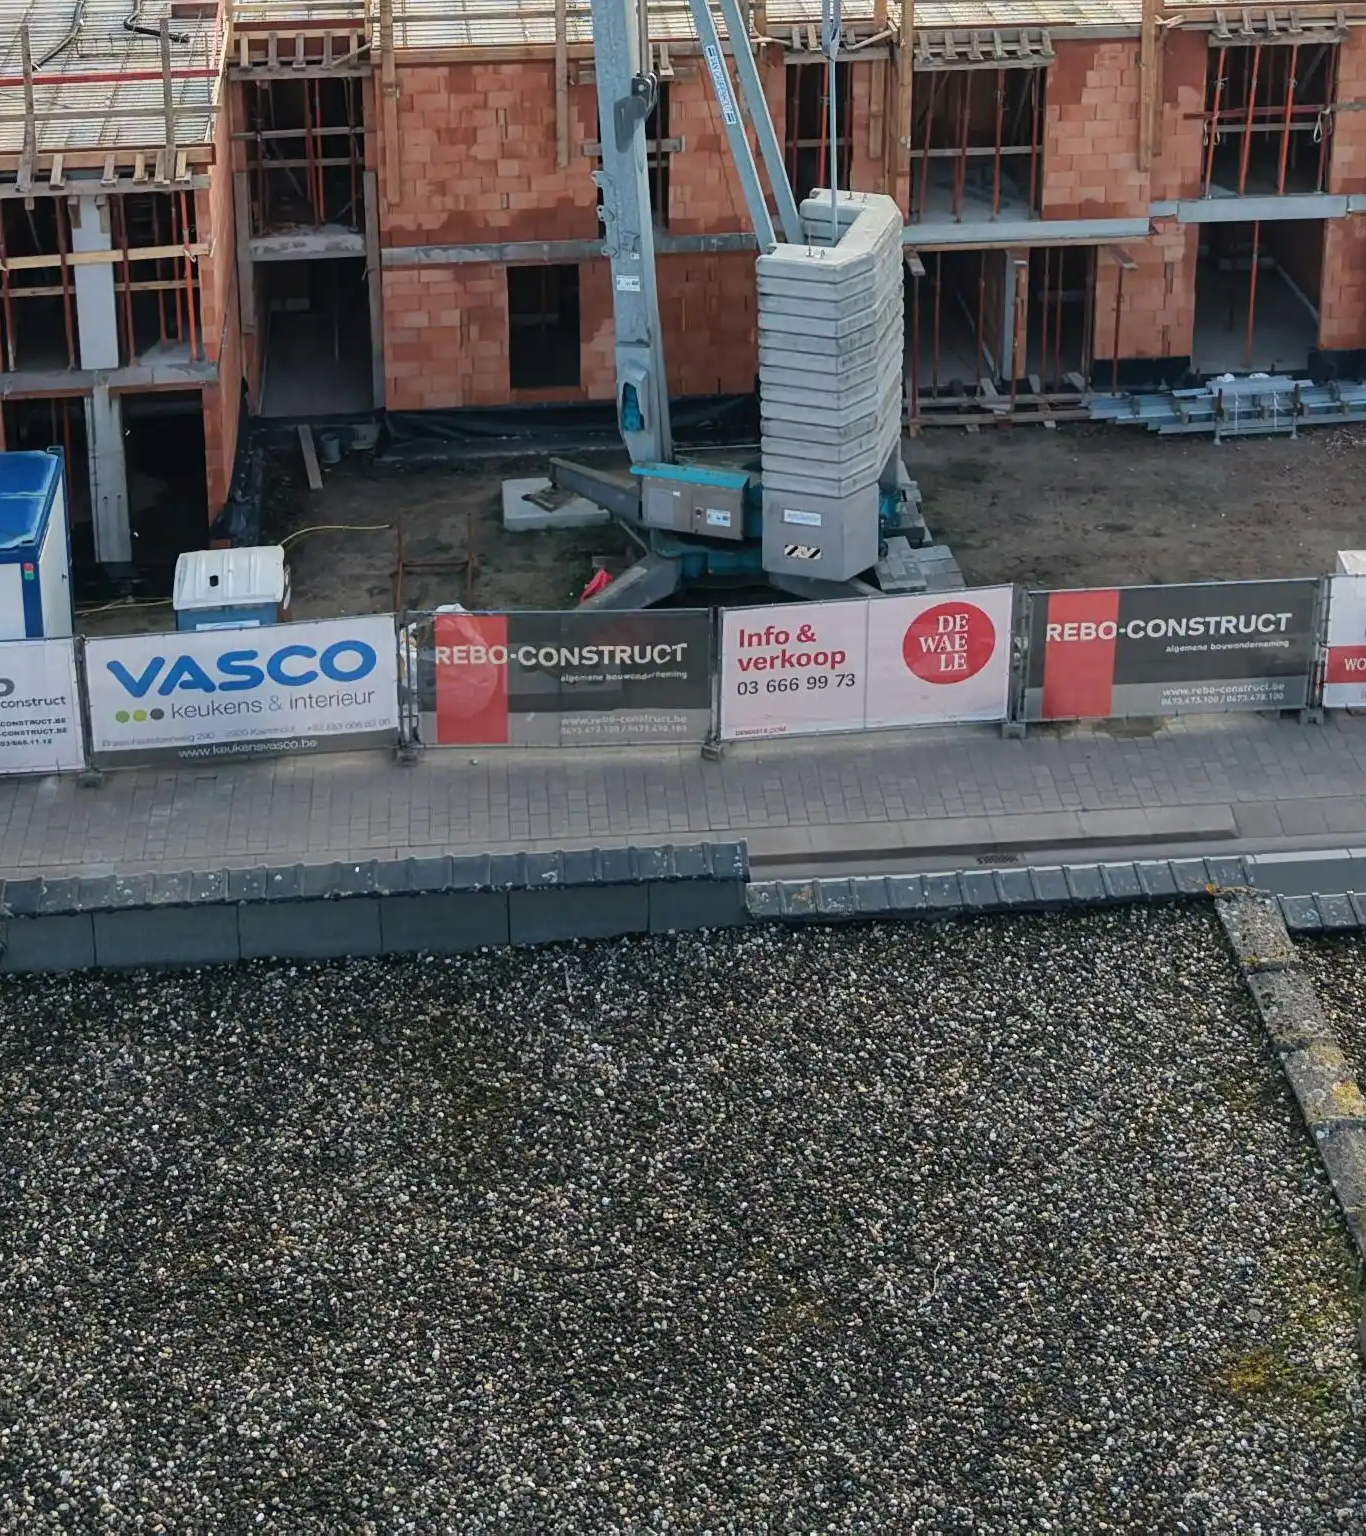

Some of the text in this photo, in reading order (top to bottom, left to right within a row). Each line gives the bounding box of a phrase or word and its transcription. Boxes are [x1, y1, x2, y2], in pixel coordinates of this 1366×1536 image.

[937, 614, 969, 634] DE
[1045, 613, 1293, 643] REBO-CONSTRUCT
[739, 624, 817, 648] Info &
[919, 633, 967, 653] WAE
[435, 643, 688, 666] REBO-CONSTRUCT
[1166, 640, 1289, 654] algemene bouwonderneming
[107, 640, 377, 698] VASCO
[738, 649, 846, 672] verkoop
[939, 653, 967, 672] LE
[561, 674, 603, 683] algemene
[737, 673, 856, 696] 03 666 99 73
[0, 695, 66, 709] construct
[171, 690, 376, 720] keukens & interieur
[178, 740, 318, 758] www.keukensvasco.be
